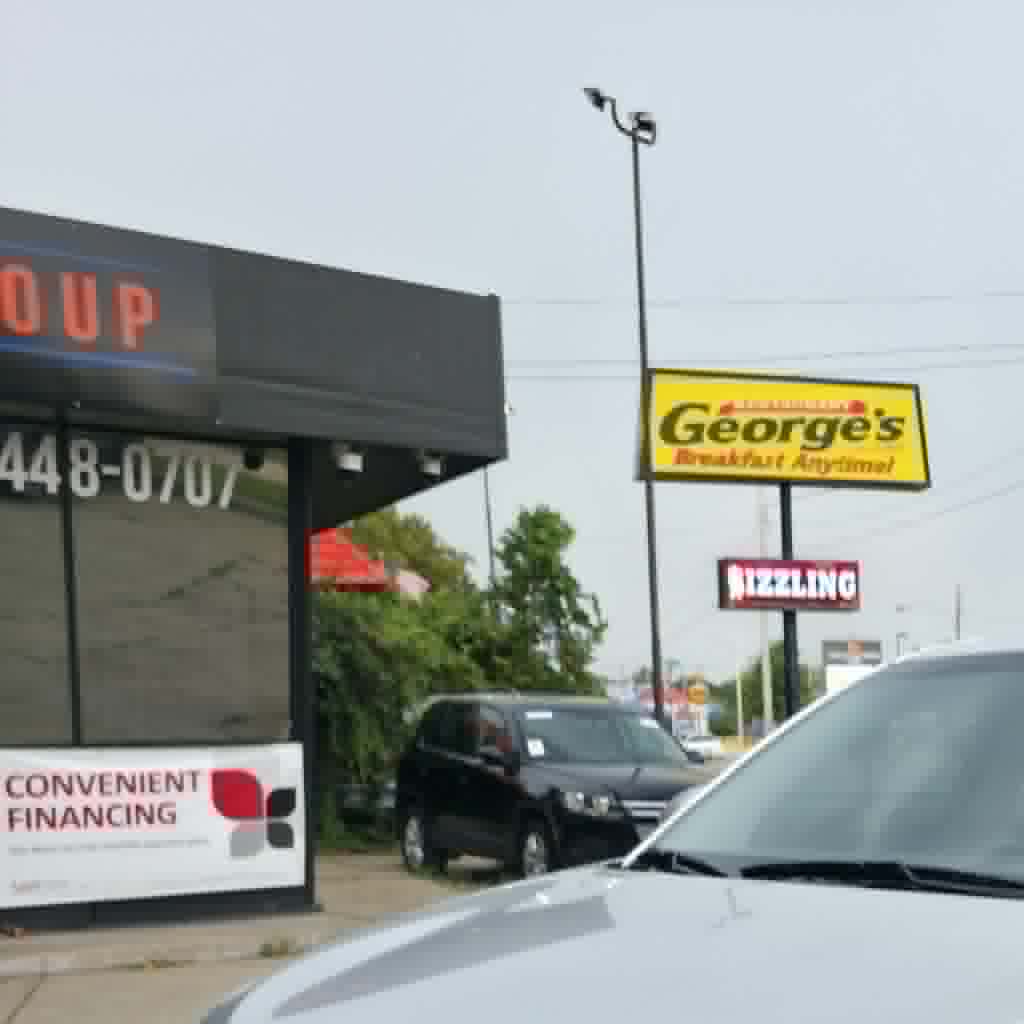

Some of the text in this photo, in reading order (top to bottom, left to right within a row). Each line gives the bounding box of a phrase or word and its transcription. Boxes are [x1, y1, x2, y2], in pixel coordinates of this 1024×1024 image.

[659, 402, 904, 449] George's
[0, 432, 243, 510] 448-0707
[5, 769, 200, 799] CONVENIENT
[8, 802, 177, 832] FINANCING
